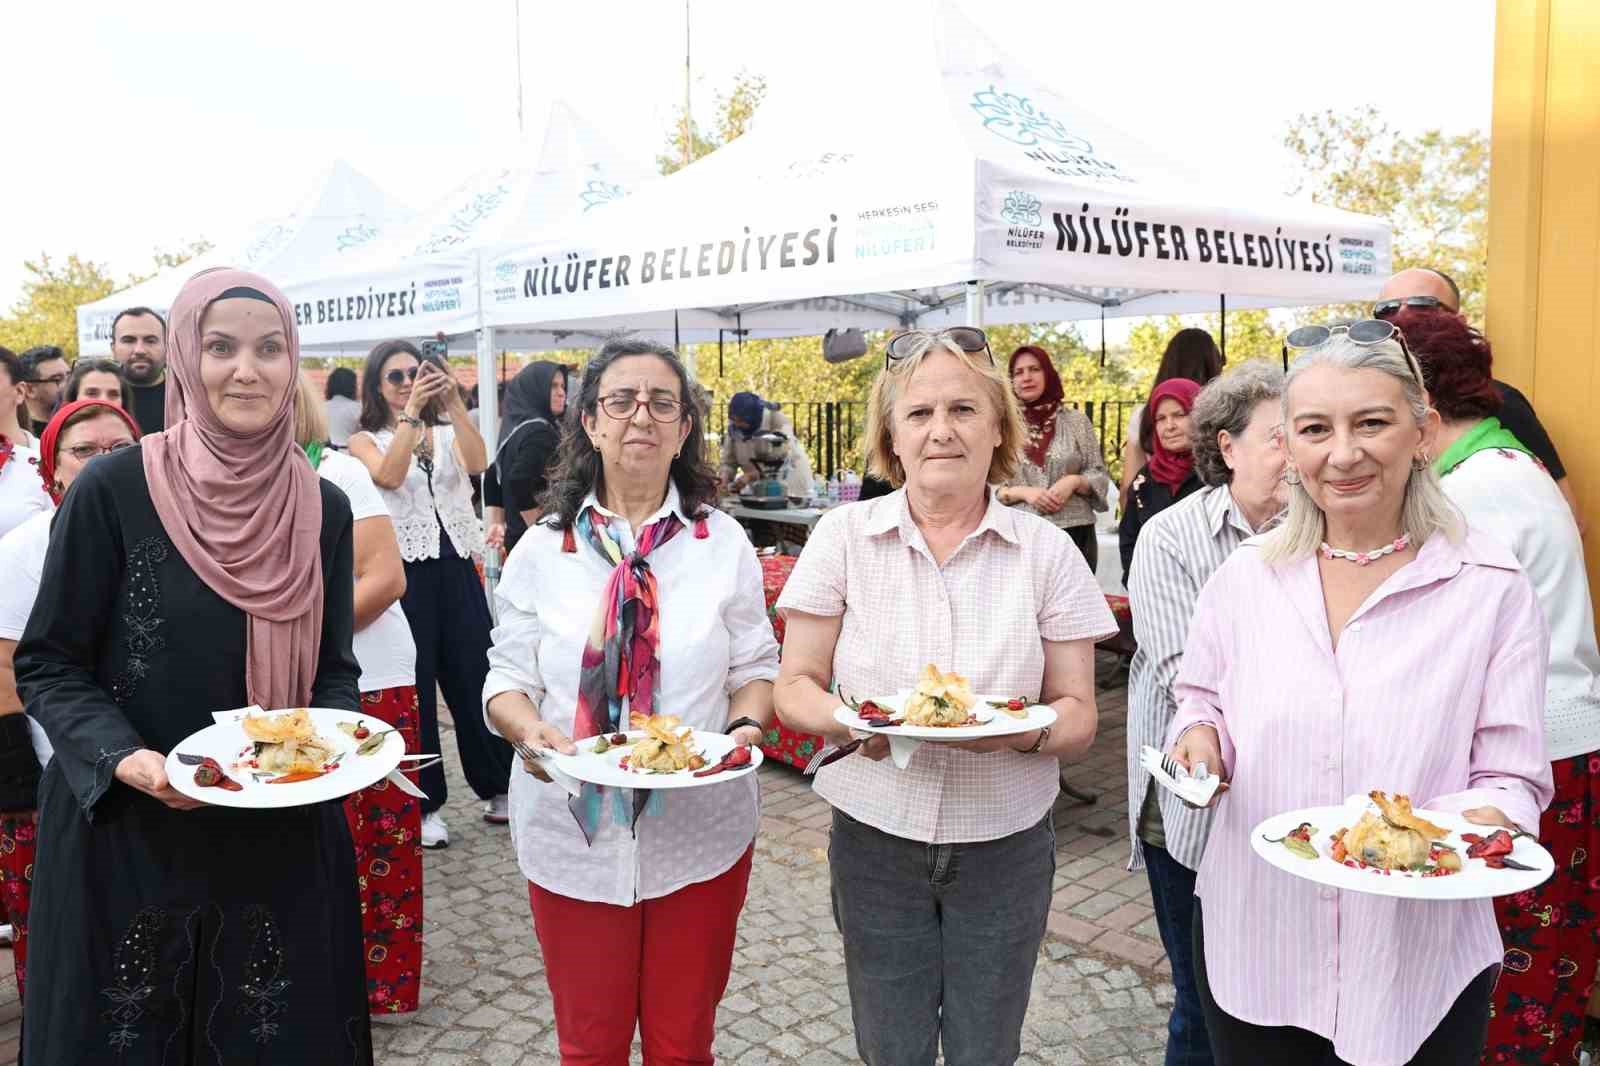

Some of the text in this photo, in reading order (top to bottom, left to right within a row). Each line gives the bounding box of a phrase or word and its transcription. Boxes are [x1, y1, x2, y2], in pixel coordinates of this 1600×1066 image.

[524, 213, 838, 298] NİLÜFER BELEDİYESİ
[1007, 226, 1044, 240] NİLÜFER
[1053, 202, 1334, 274] NİLÜFER BELEDİYESİ
[317, 280, 417, 324] BELEDİYESİ
